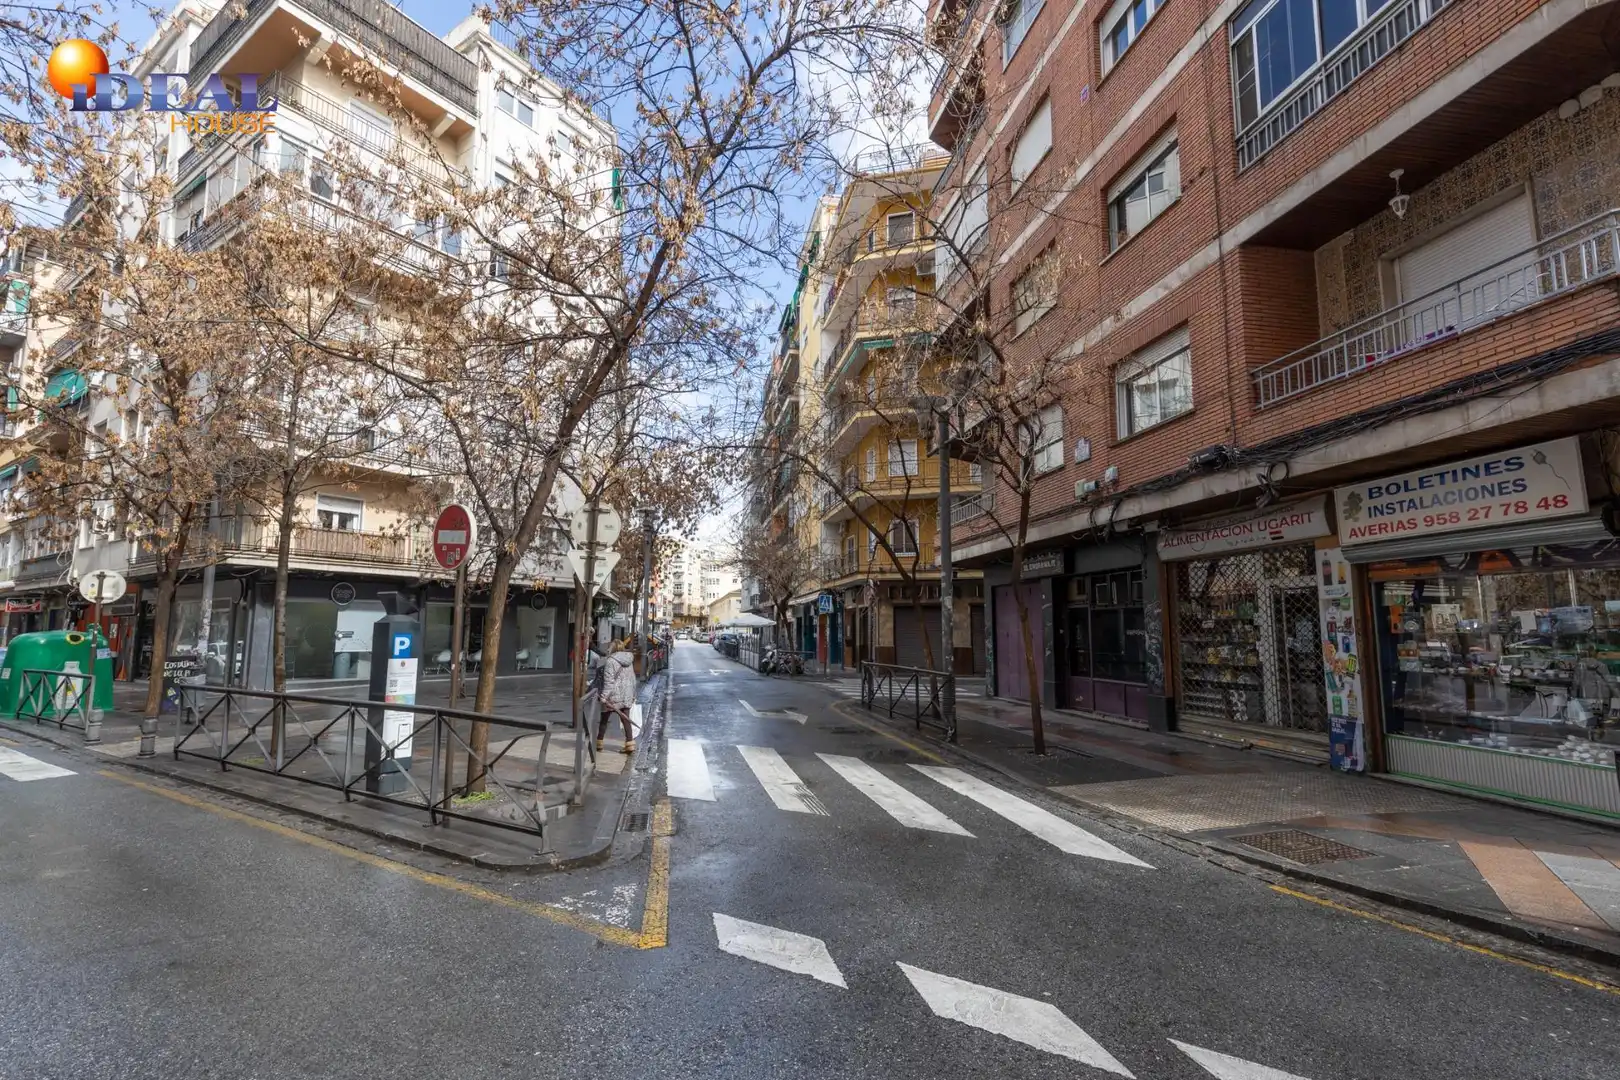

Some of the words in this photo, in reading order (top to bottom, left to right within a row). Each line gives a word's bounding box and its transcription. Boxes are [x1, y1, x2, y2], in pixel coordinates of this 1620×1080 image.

[1367, 456, 1526, 500] BOLETINES
[1367, 477, 1528, 519] INSTALACIONES
[1257, 511, 1315, 532] UGARIT
[1348, 517, 1419, 539] AVERIAS
[1422, 511, 1461, 528] 958
[1467, 505, 1493, 522] 27
[1499, 500, 1530, 517] 78
[1536, 493, 1570, 512] 48
[394, 636, 411, 656] P
